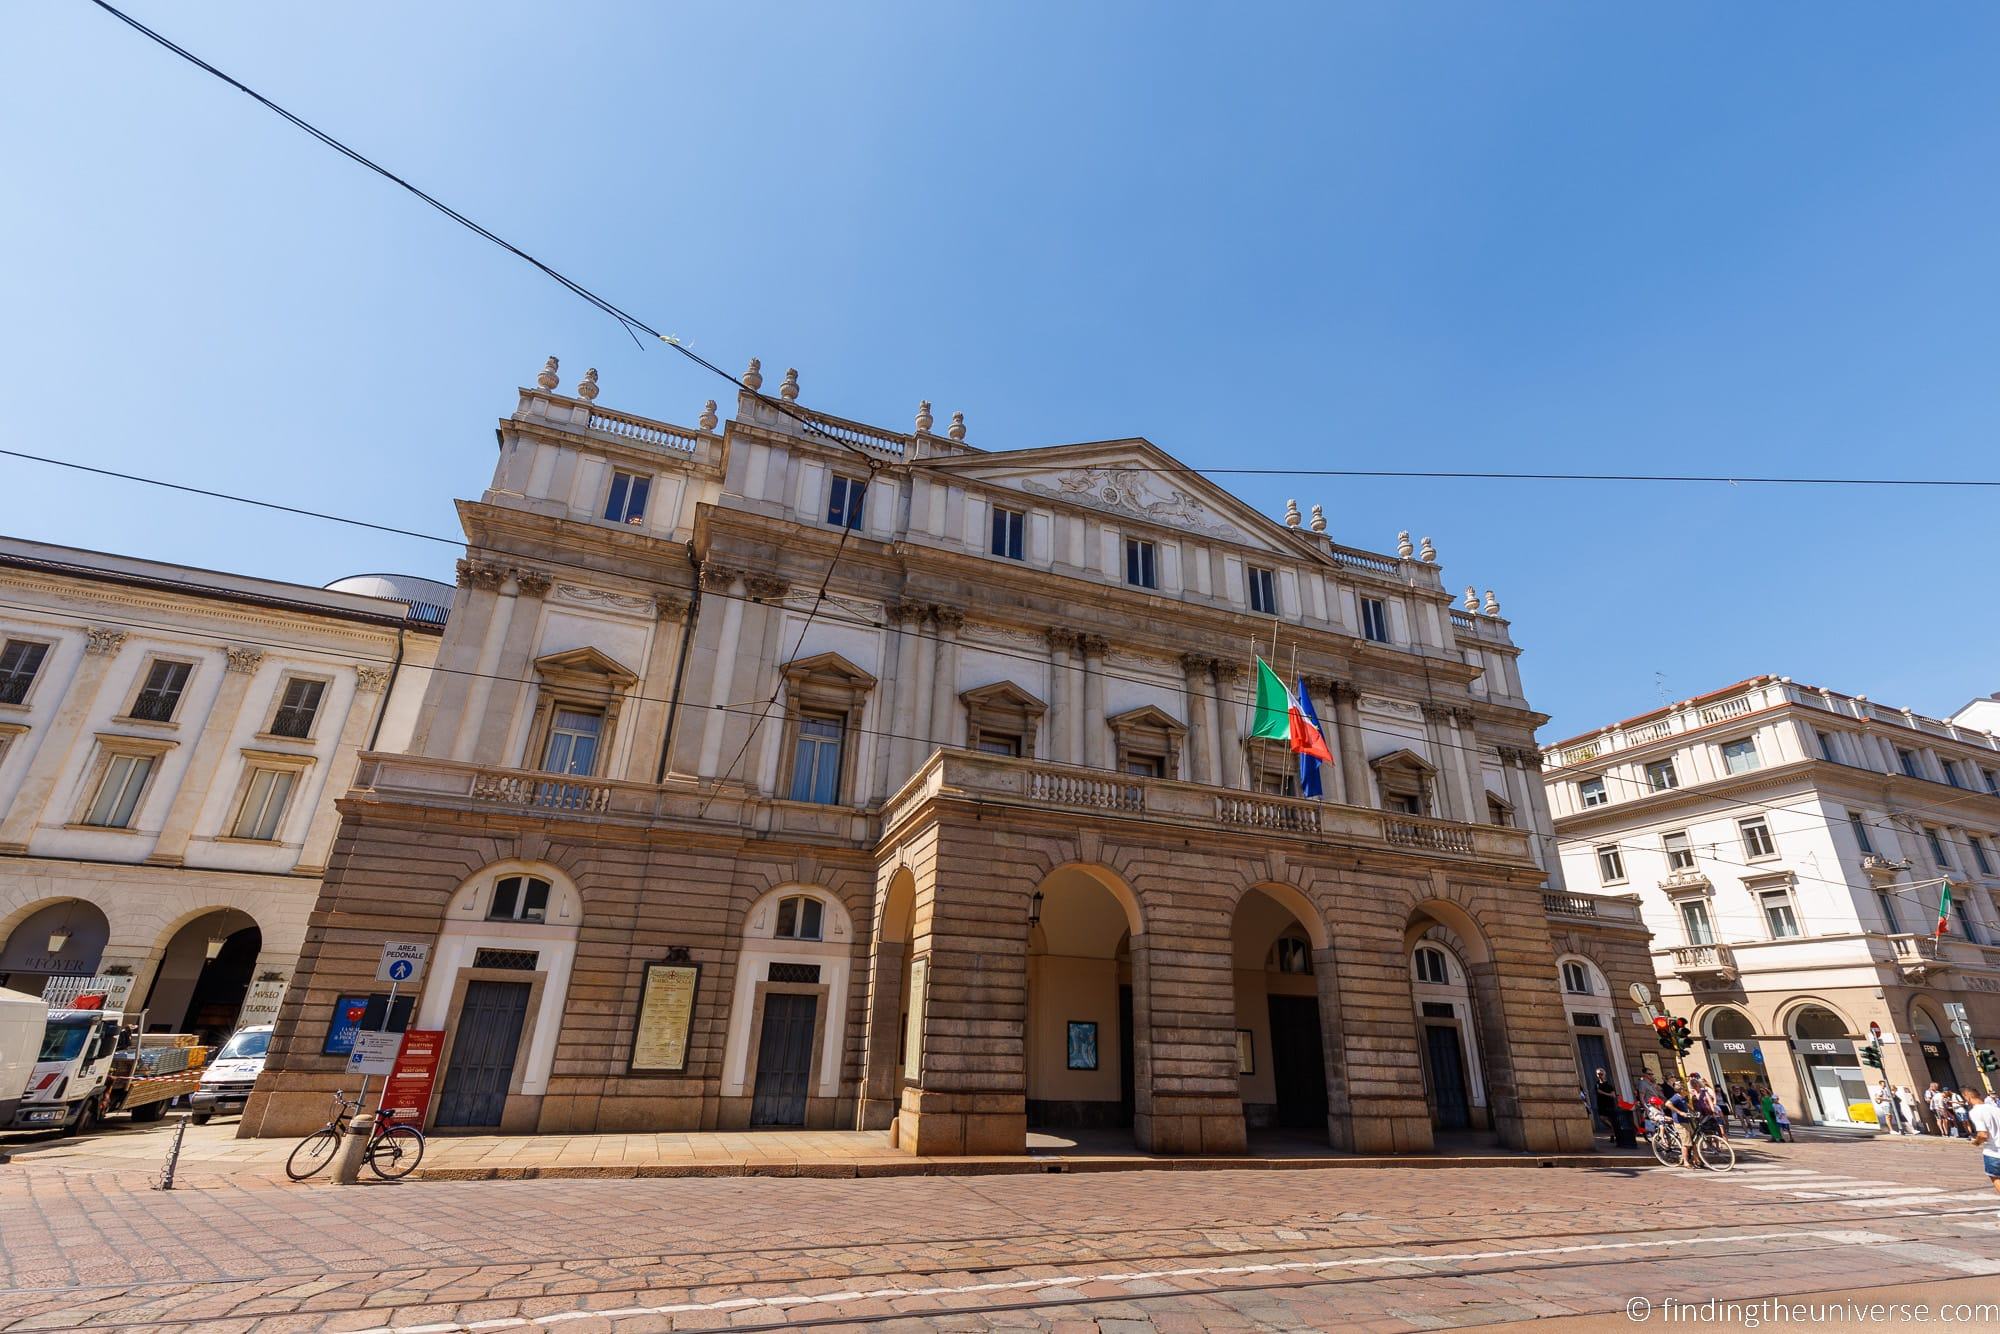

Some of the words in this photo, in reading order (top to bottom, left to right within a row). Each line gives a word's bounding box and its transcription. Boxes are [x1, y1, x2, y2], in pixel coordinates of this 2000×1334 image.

[397, 944, 417, 952] AREA
[385, 950, 425, 960] PEDONALE
[34, 958, 84, 971] FOYER
[246, 1004, 280, 1013] TEATRALE
[1723, 1042, 1746, 1051] FENDI
[1811, 1042, 1837, 1051] FENDI
[1923, 1044, 1938, 1053] FENDI
